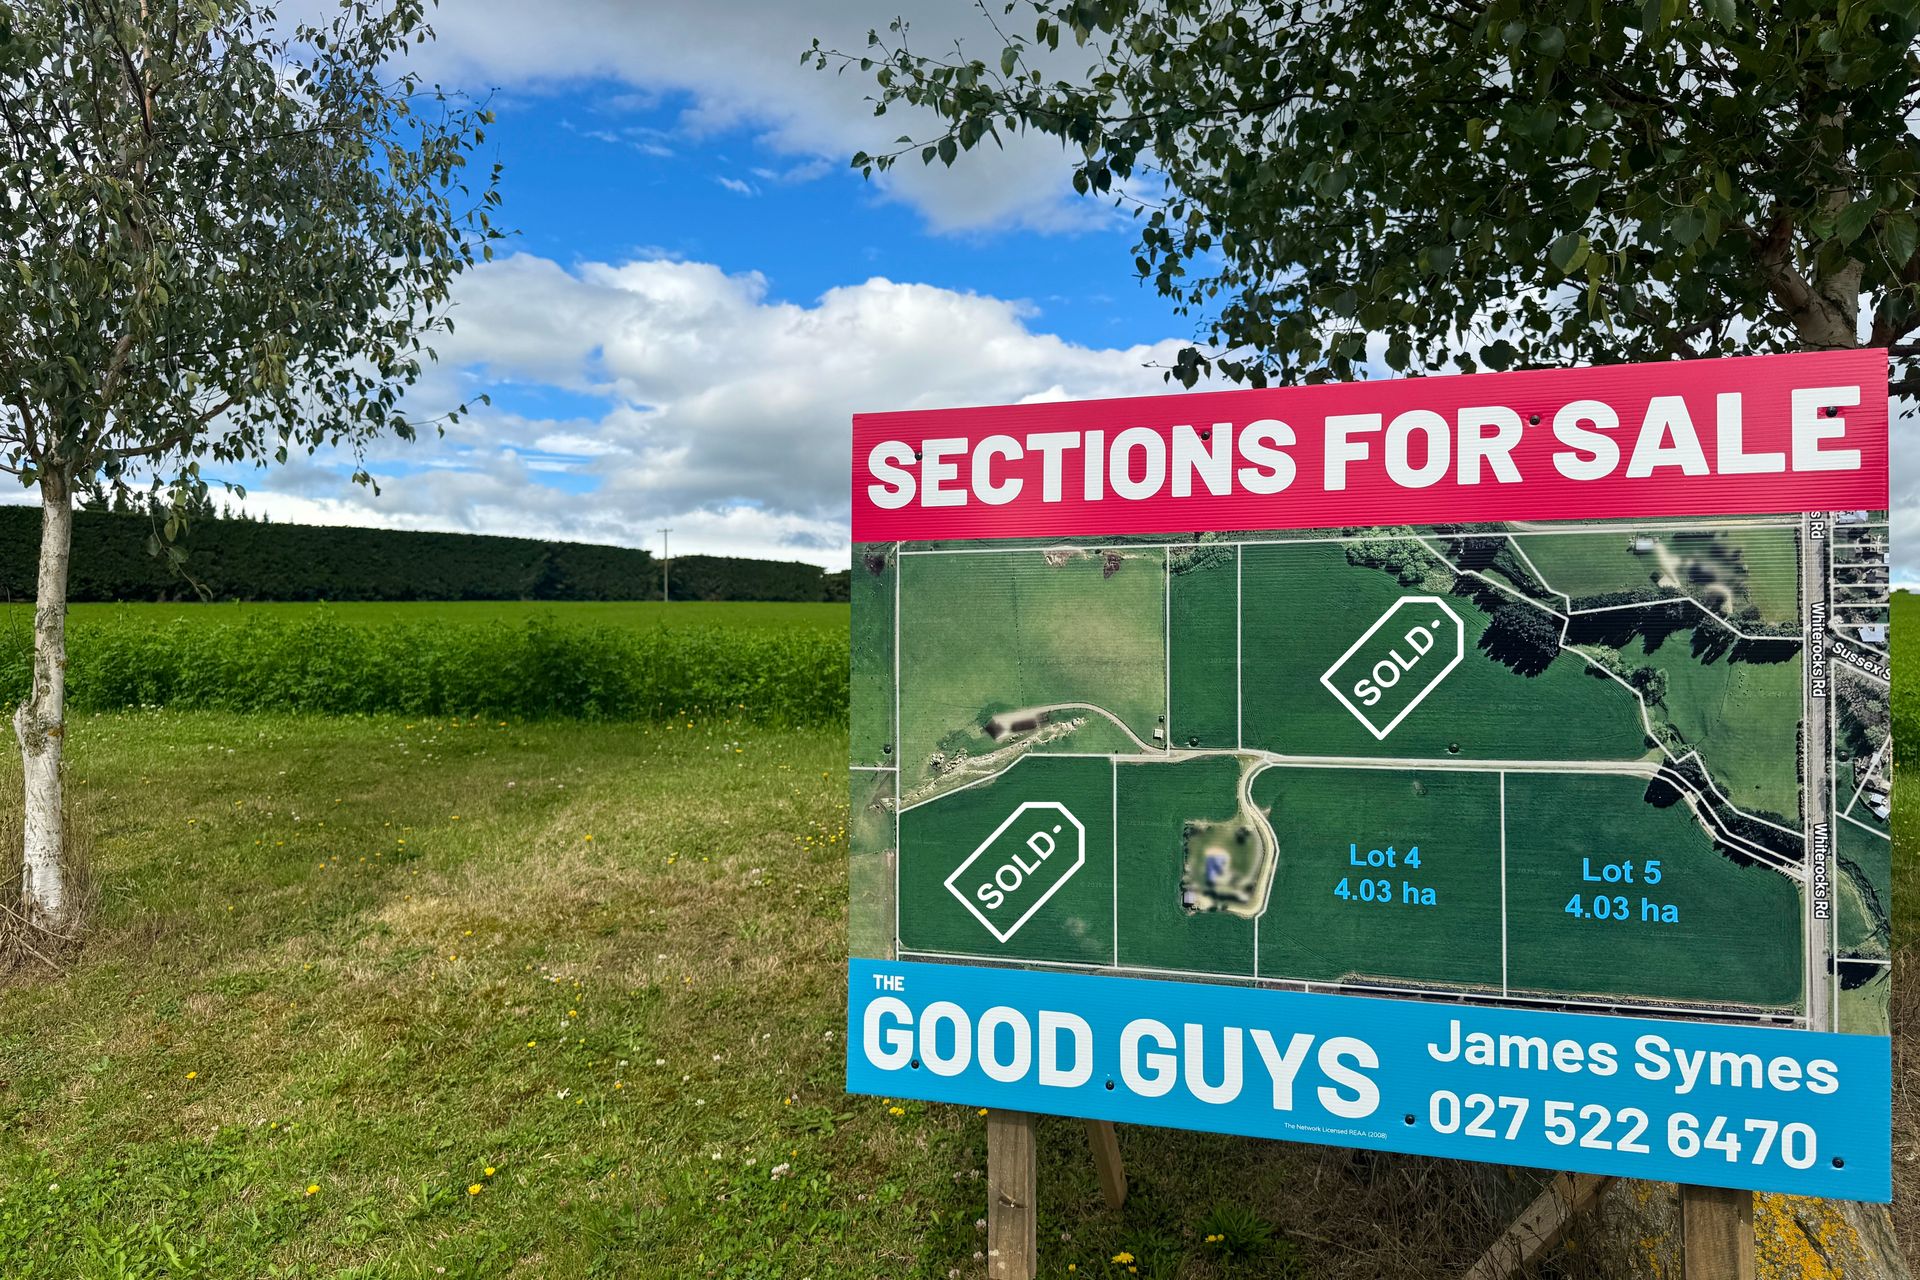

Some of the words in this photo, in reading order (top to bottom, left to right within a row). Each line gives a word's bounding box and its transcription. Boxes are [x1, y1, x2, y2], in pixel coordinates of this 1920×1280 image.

[867, 419, 1297, 510] SECTIONS
[1324, 406, 1523, 491] FOR
[1552, 386, 1861, 481] SALE
[1811, 522, 1825, 539] Rd
[1811, 602, 1826, 676] Whiterocks
[1354, 626, 1434, 706] SOLD
[1832, 642, 1882, 676] Sussex
[1812, 679, 1826, 697] Rd
[977, 830, 1056, 910] SOLD
[1350, 843, 1396, 868] Lot
[1404, 846, 1422, 869] 4
[1583, 857, 1635, 884] Lot
[1643, 860, 1662, 884] 5
[1814, 823, 1829, 898] Whiterocks
[1334, 877, 1392, 903] 4.03
[1402, 881, 1437, 906] ha
[1564, 893, 1629, 921] 4.03
[1641, 897, 1679, 923] ha
[1815, 901, 1829, 919] Rd
[873, 974, 905, 992] THE
[863, 996, 1093, 1088] GOOD
[1119, 1018, 1380, 1119] GUYS
[1427, 1019, 1618, 1076] James
[1634, 1034, 1839, 1095] Symes
[1296, 1123, 1321, 1131] Network
[1367, 1131, 1388, 1139] (2008)
[1429, 1090, 1529, 1140] 027
[1544, 1100, 1650, 1154] 522
[1667, 1112, 1817, 1170] 6470
